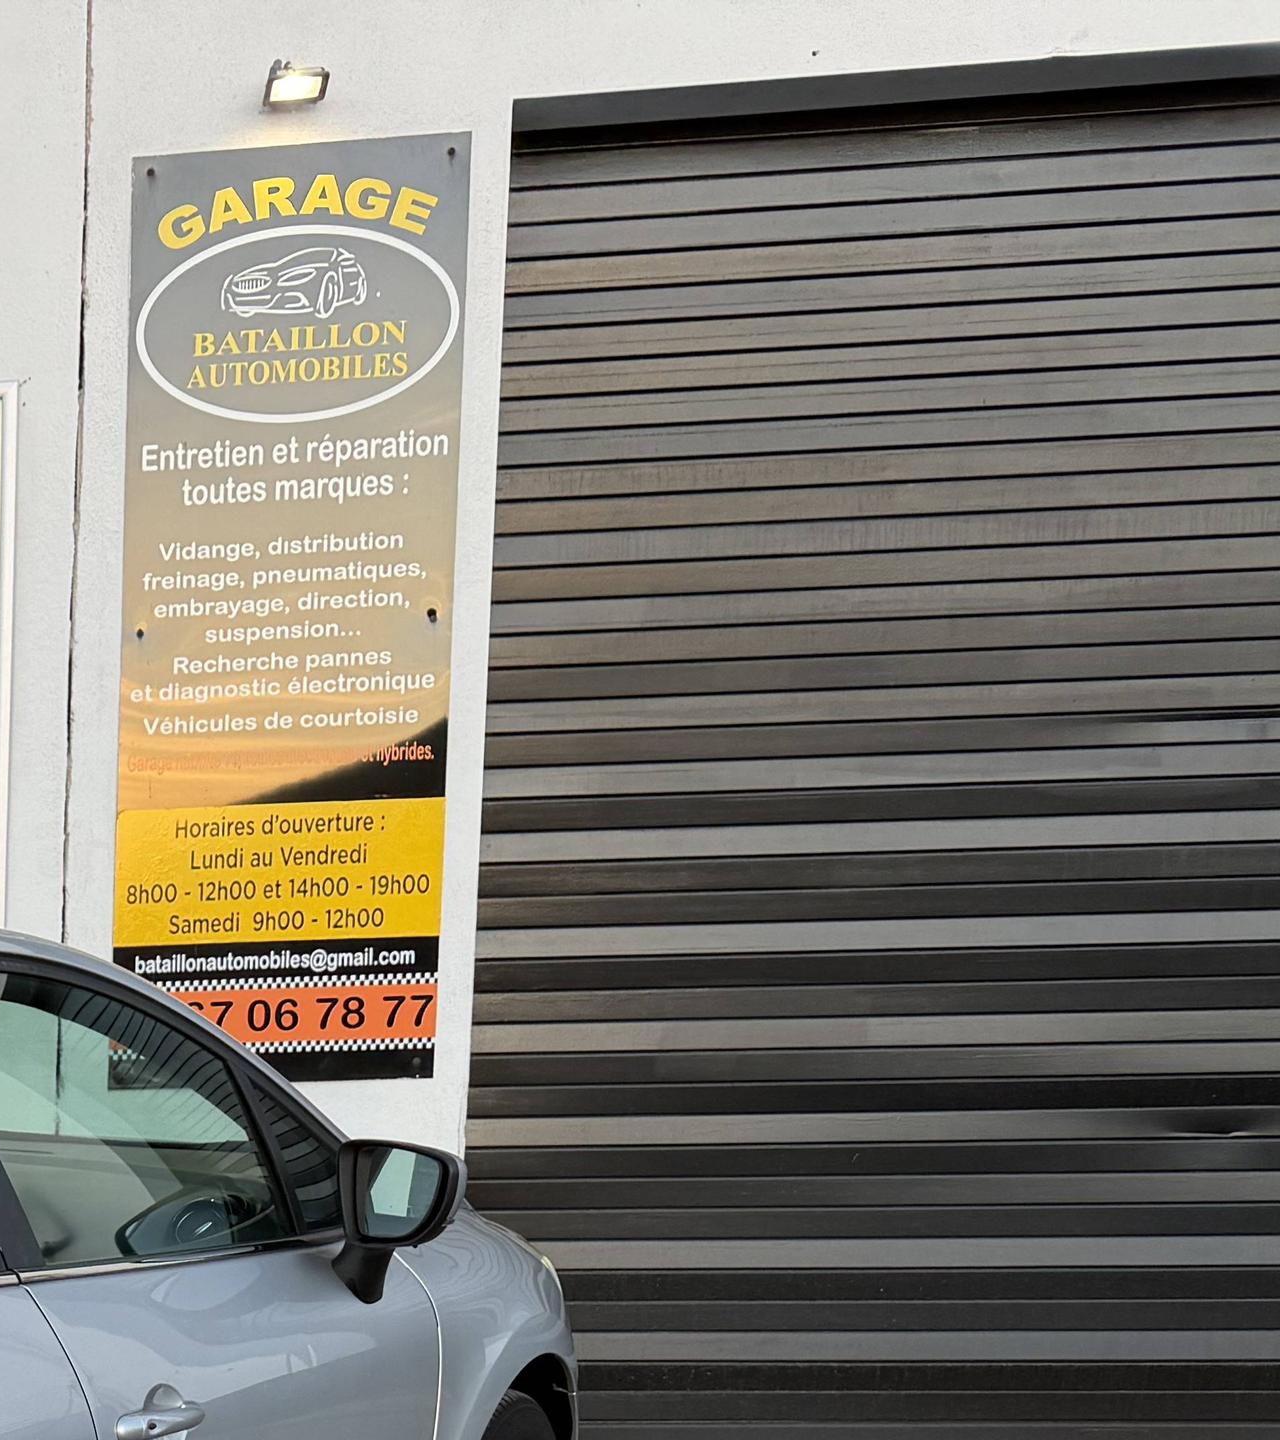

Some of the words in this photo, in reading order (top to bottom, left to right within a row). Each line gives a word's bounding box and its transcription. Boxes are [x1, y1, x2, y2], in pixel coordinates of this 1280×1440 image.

[157, 174, 438, 250] GARAGE
[192, 319, 407, 358] BATAILLON
[186, 352, 409, 390] AUTOMOBILES
[142, 439, 264, 472] Entretien
[272, 436, 299, 464] et
[306, 429, 449, 468] réparation
[182, 476, 267, 506] toutes
[275, 474, 394, 505] marques
[159, 541, 261, 562] Vidange,
[268, 531, 404, 556] distribution
[142, 571, 245, 592] freinage,
[252, 560, 427, 589] pneumatiques,
[154, 597, 290, 620] embrayage,
[297, 589, 410, 612] direction,
[205, 621, 361, 645] suspension...
[173, 653, 299, 675] Recherche
[305, 649, 392, 673] pannes
[130, 686, 153, 703] et
[159, 678, 281, 705] diagnostic
[287, 671, 436, 698] électronique
[143, 713, 257, 736] Véhicules
[264, 711, 293, 731] de
[300, 706, 419, 729] courtoisie
[175, 817, 255, 840] Horaires
[190, 848, 244, 870] Lundi
[250, 851, 273, 868] au
[280, 844, 368, 867] Vendredi
[126, 883, 178, 904] 8h00
[198, 880, 257, 902] 12h00
[263, 880, 282, 899] et
[288, 877, 350, 899] 14h00
[370, 874, 430, 895] 19h00
[169, 912, 241, 935] Samedi
[253, 910, 305, 932] 9h00
[325, 907, 384, 929] 12h00
[134, 947, 416, 976] bataillonautomobiles@gmail.com
[188, 1001, 233, 1028] 7
[247, 998, 299, 1033] 06
[315, 996, 366, 1030] 78
[382, 993, 435, 1029] 77
